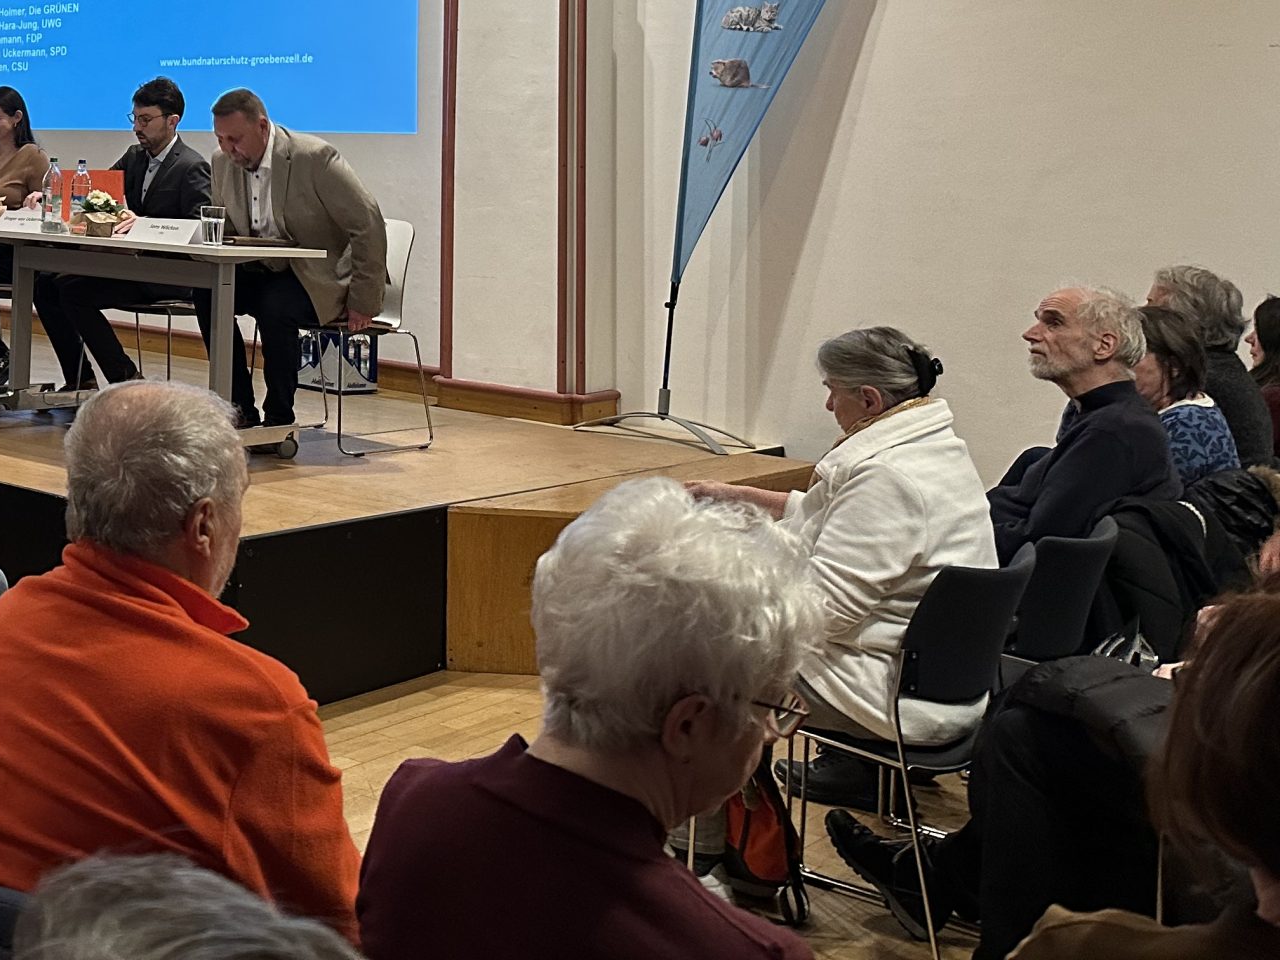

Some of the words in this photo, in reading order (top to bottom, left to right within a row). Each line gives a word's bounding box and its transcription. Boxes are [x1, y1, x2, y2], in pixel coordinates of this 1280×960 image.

[29, 5, 42, 15] Die
[43, 3, 79, 15] GRÜNEN
[42, 18, 62, 29] UWG
[26, 33, 43, 43] FDP
[2, 48, 48, 59] Uckermann,
[50, 46, 67, 56] SPD
[160, 53, 314, 67] www.bundnaturschutz-groebenzell.de
[11, 61, 29, 72] CSU
